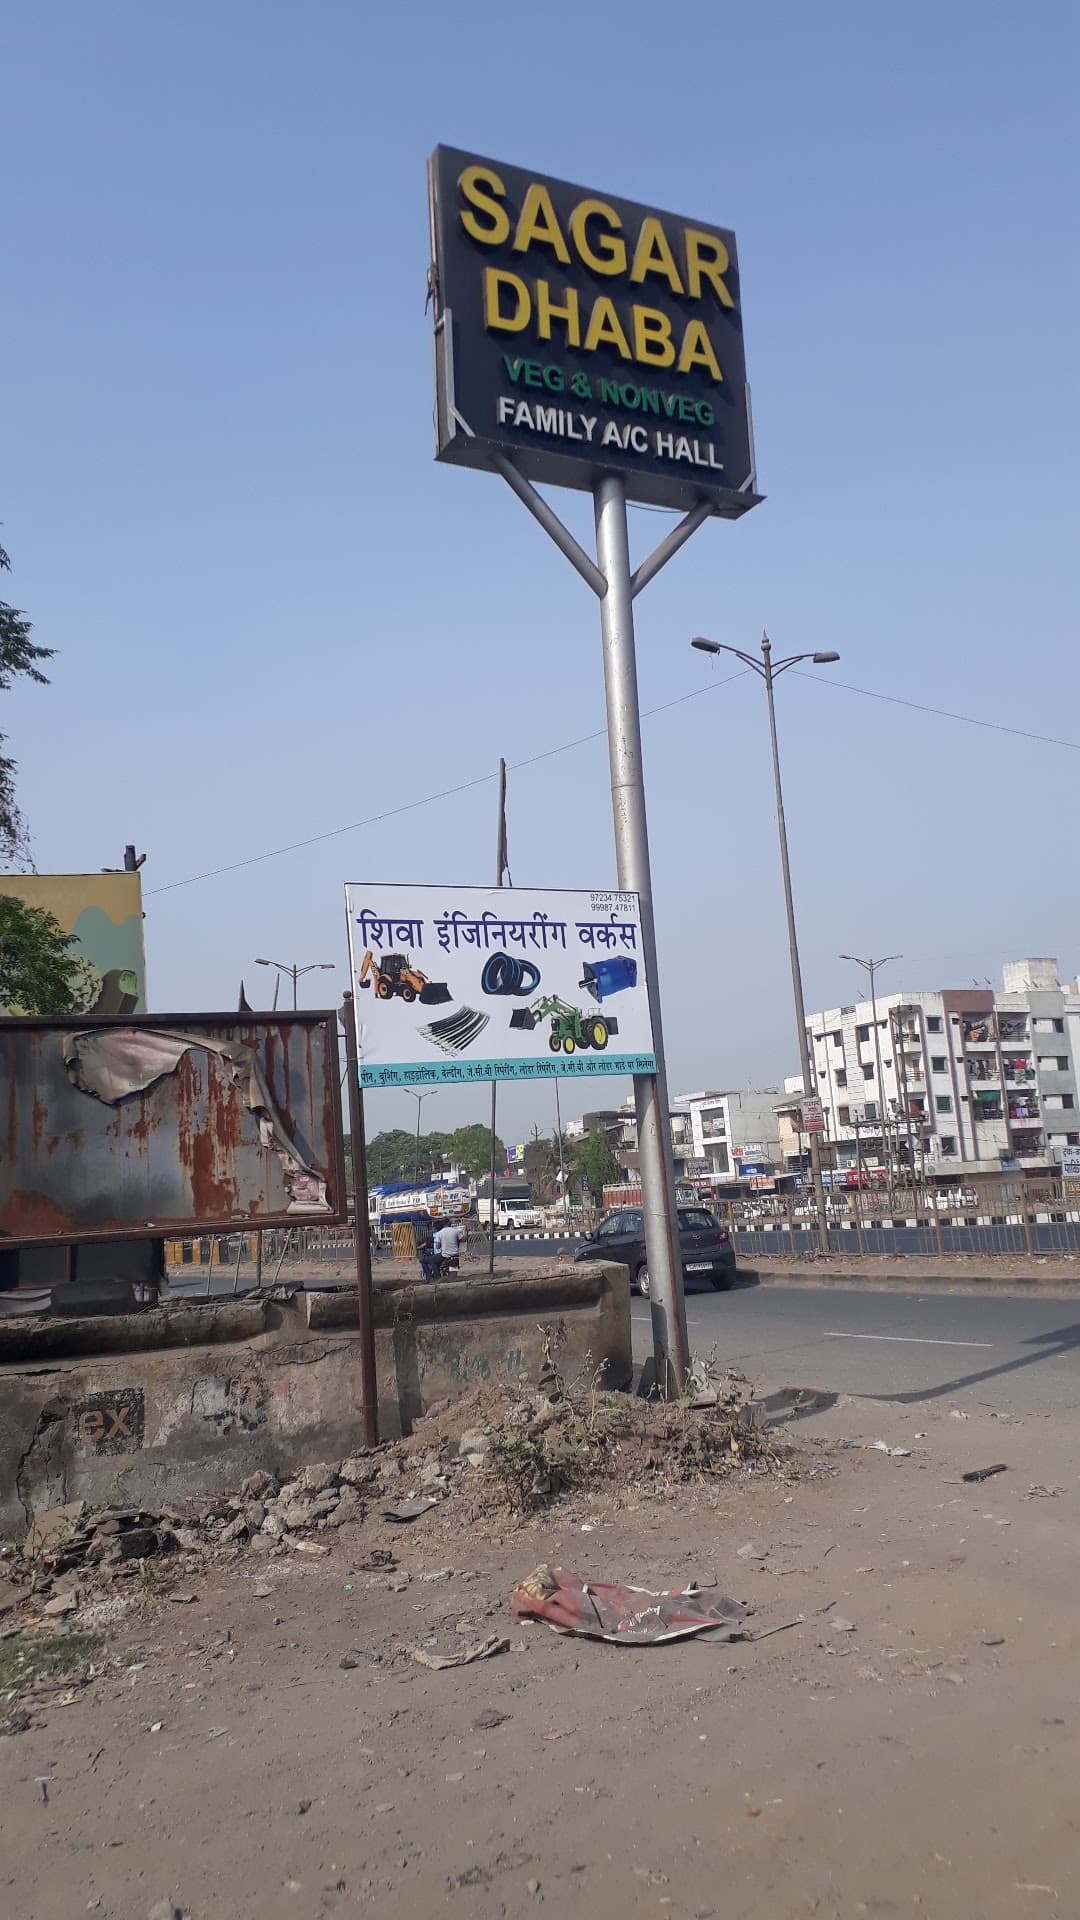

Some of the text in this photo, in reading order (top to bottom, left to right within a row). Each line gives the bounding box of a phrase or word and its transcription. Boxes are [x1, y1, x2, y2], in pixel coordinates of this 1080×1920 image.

[457, 165, 735, 309] SAGAR
[484, 266, 723, 382] DHABA
[504, 355, 715, 425] VEG & NONVEG
[497, 396, 724, 470] FAMILY A/C HALL
[356, 908, 638, 953] शिवा इंजिनियरींग वर्कस
[590, 903, 613, 911] 99987
